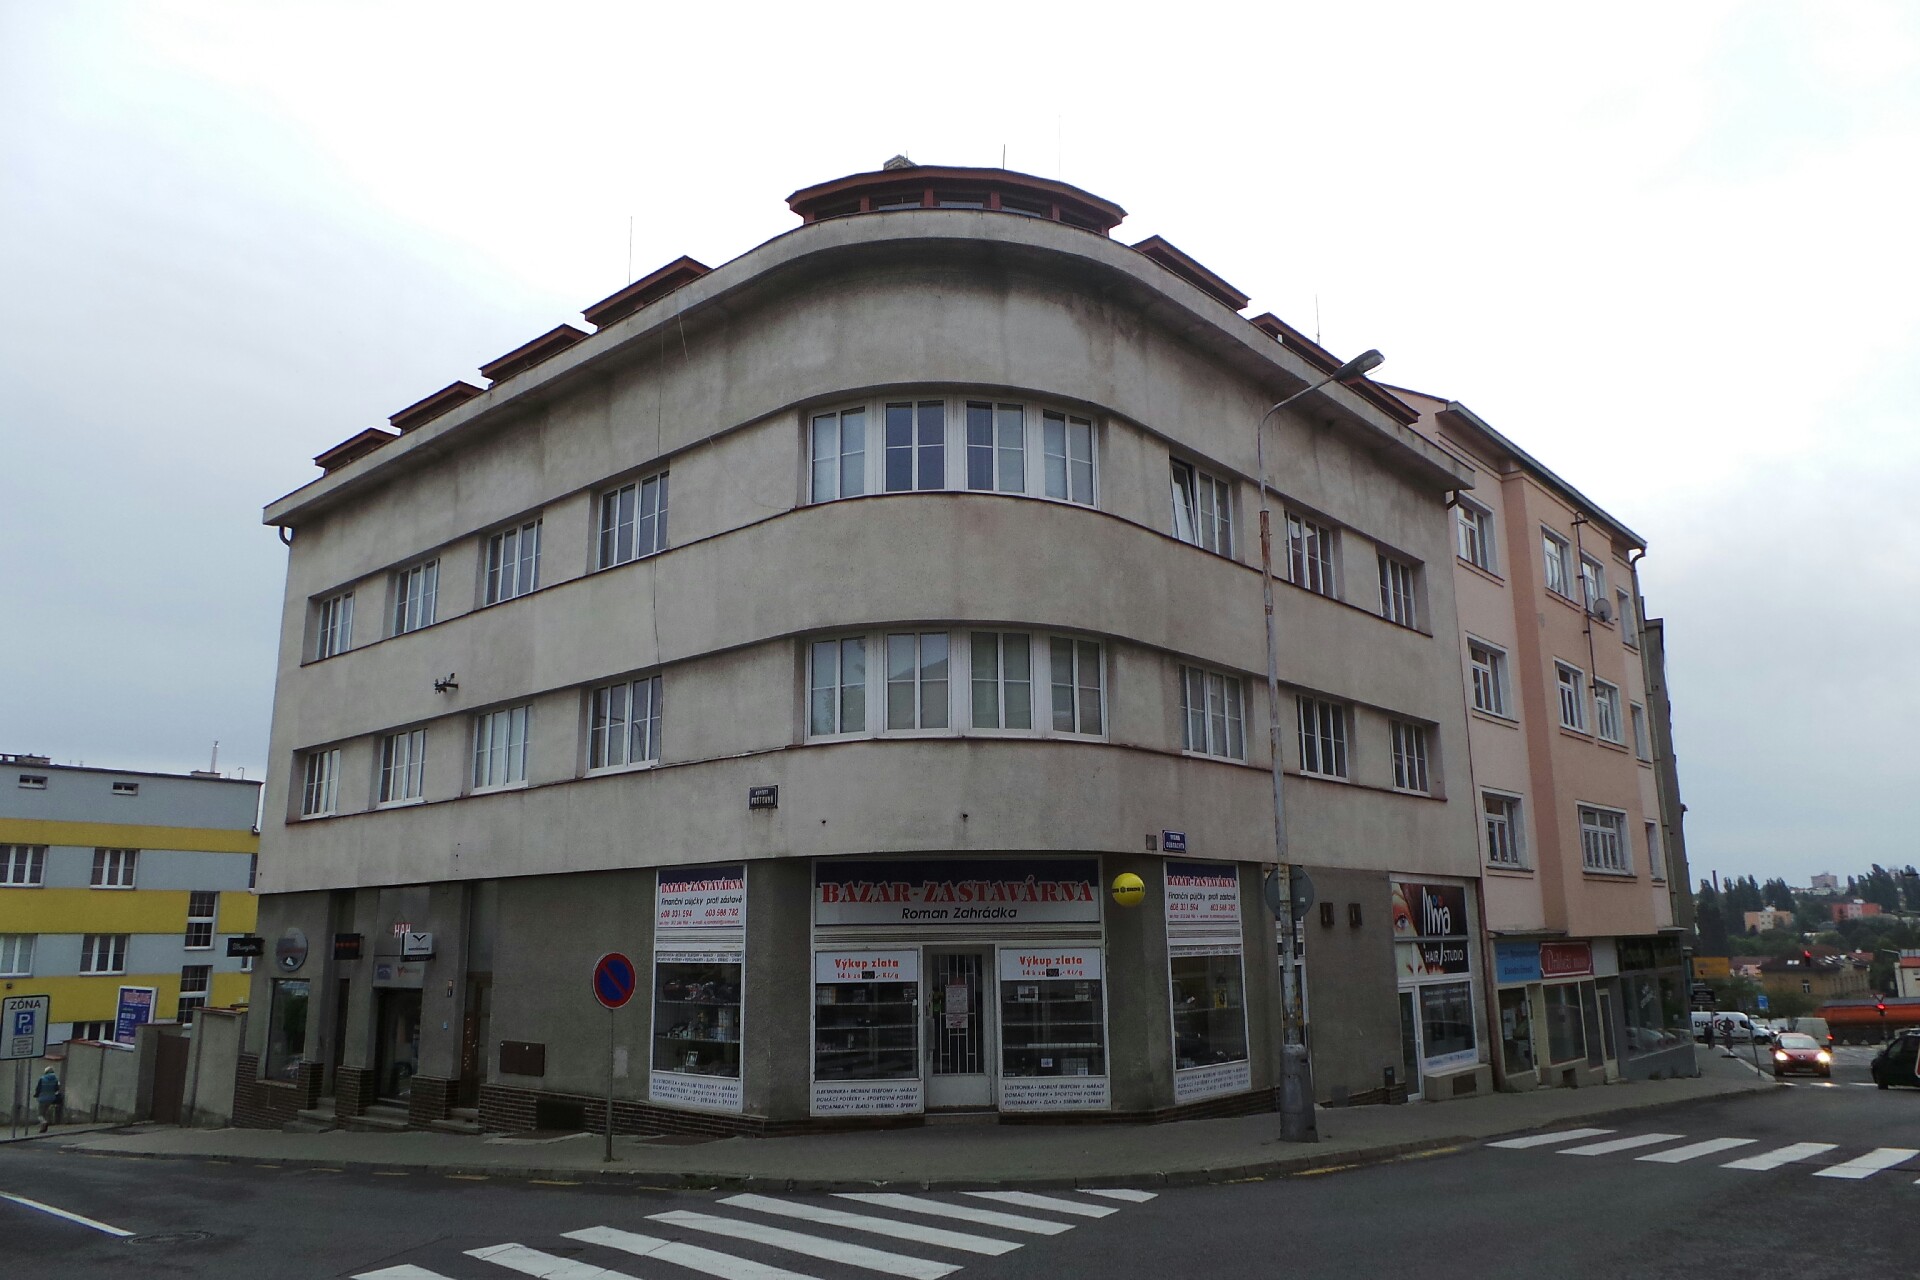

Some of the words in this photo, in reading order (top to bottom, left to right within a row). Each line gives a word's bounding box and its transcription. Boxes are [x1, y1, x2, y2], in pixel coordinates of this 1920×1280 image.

[706, 896, 719, 905] proti
[661, 910, 670, 918] 608
[672, 909, 680, 918] 331
[683, 909, 692, 917] 594
[705, 909, 715, 917] 603
[728, 908, 738, 916] 782
[902, 908, 948, 919] Roman
[953, 907, 1018, 919] Zahrádka
[1019, 955, 1052, 967] Výkup
[1055, 955, 1083, 965] zlata
[1425, 952, 1439, 963] HAIR
[1443, 950, 1464, 962] STUDIO
[835, 958, 867, 970] Výkup
[871, 958, 899, 968] zlata
[10, 999, 41, 1010] ZÓNA
[19, 1014, 31, 1029] P
